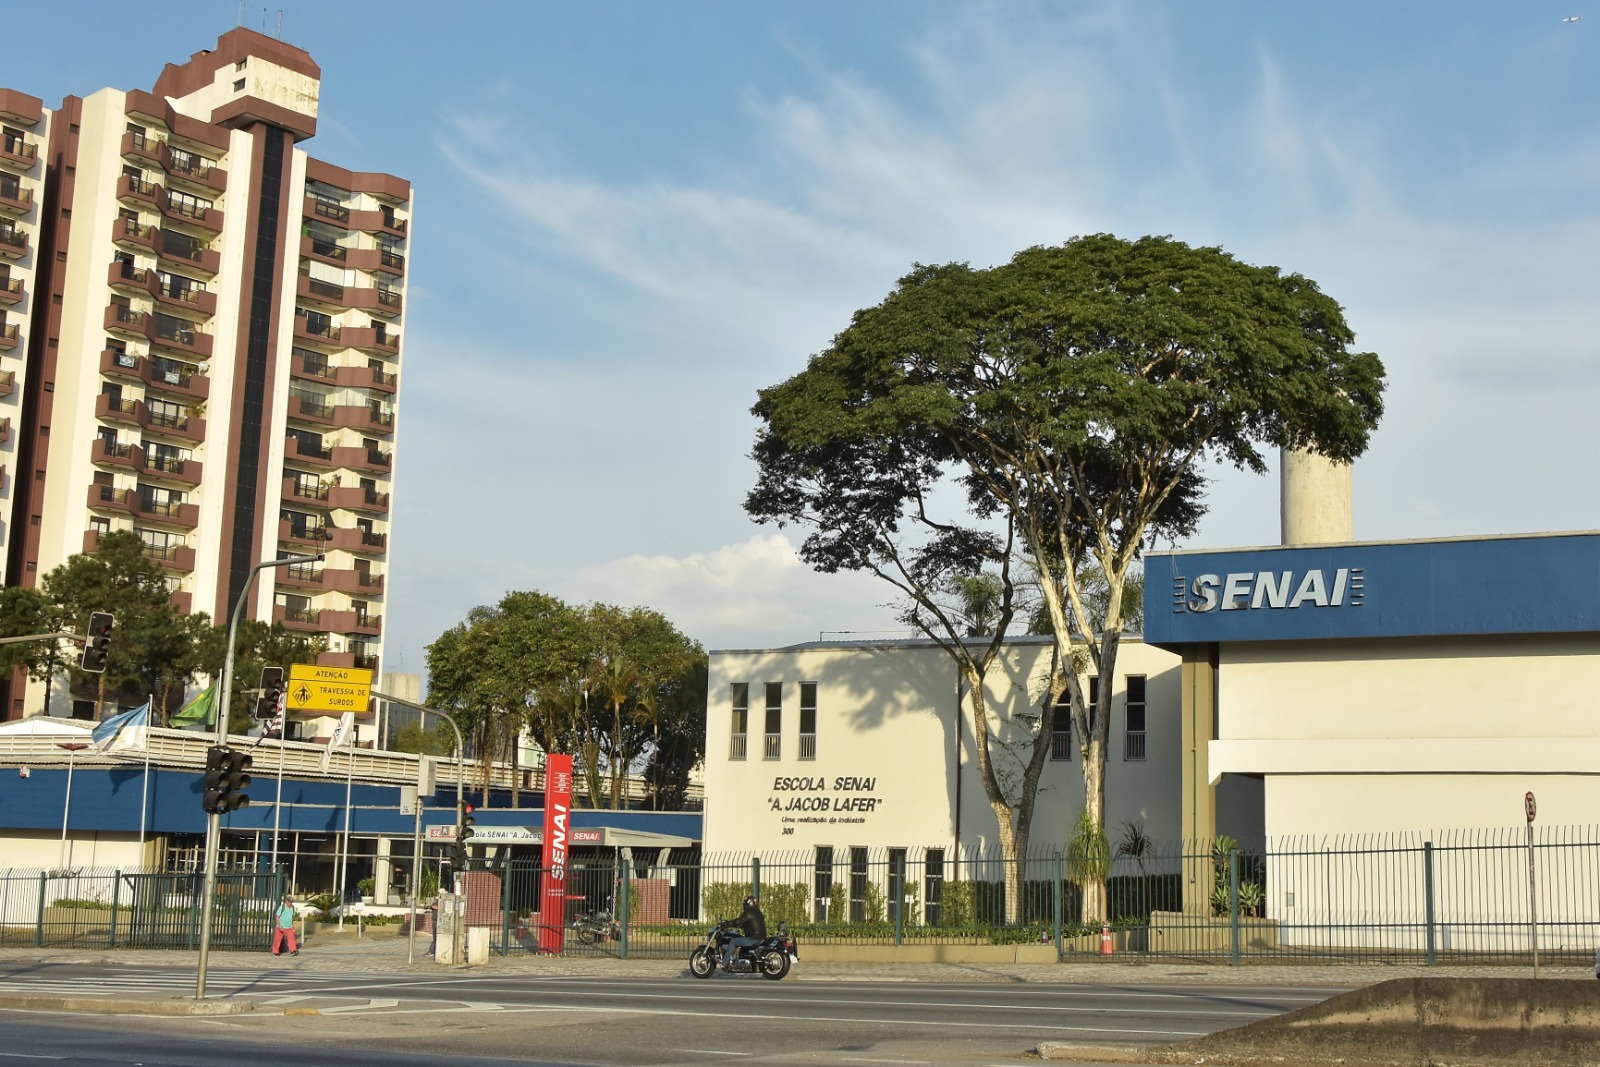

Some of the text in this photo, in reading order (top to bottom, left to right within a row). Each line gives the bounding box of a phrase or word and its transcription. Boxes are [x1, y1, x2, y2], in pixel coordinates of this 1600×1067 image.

[1188, 568, 1348, 612] SENAI
[320, 686, 366, 697] TRAVESSIA DE
[328, 698, 354, 707] SURDOS
[773, 777, 876, 791] ESCOLA SENAI
[785, 797, 830, 811] JACOB
[487, 830, 508, 838] SENAI
[573, 832, 598, 840] SENAI
[781, 827, 795, 836] 300
[551, 803, 567, 881] SENAI
